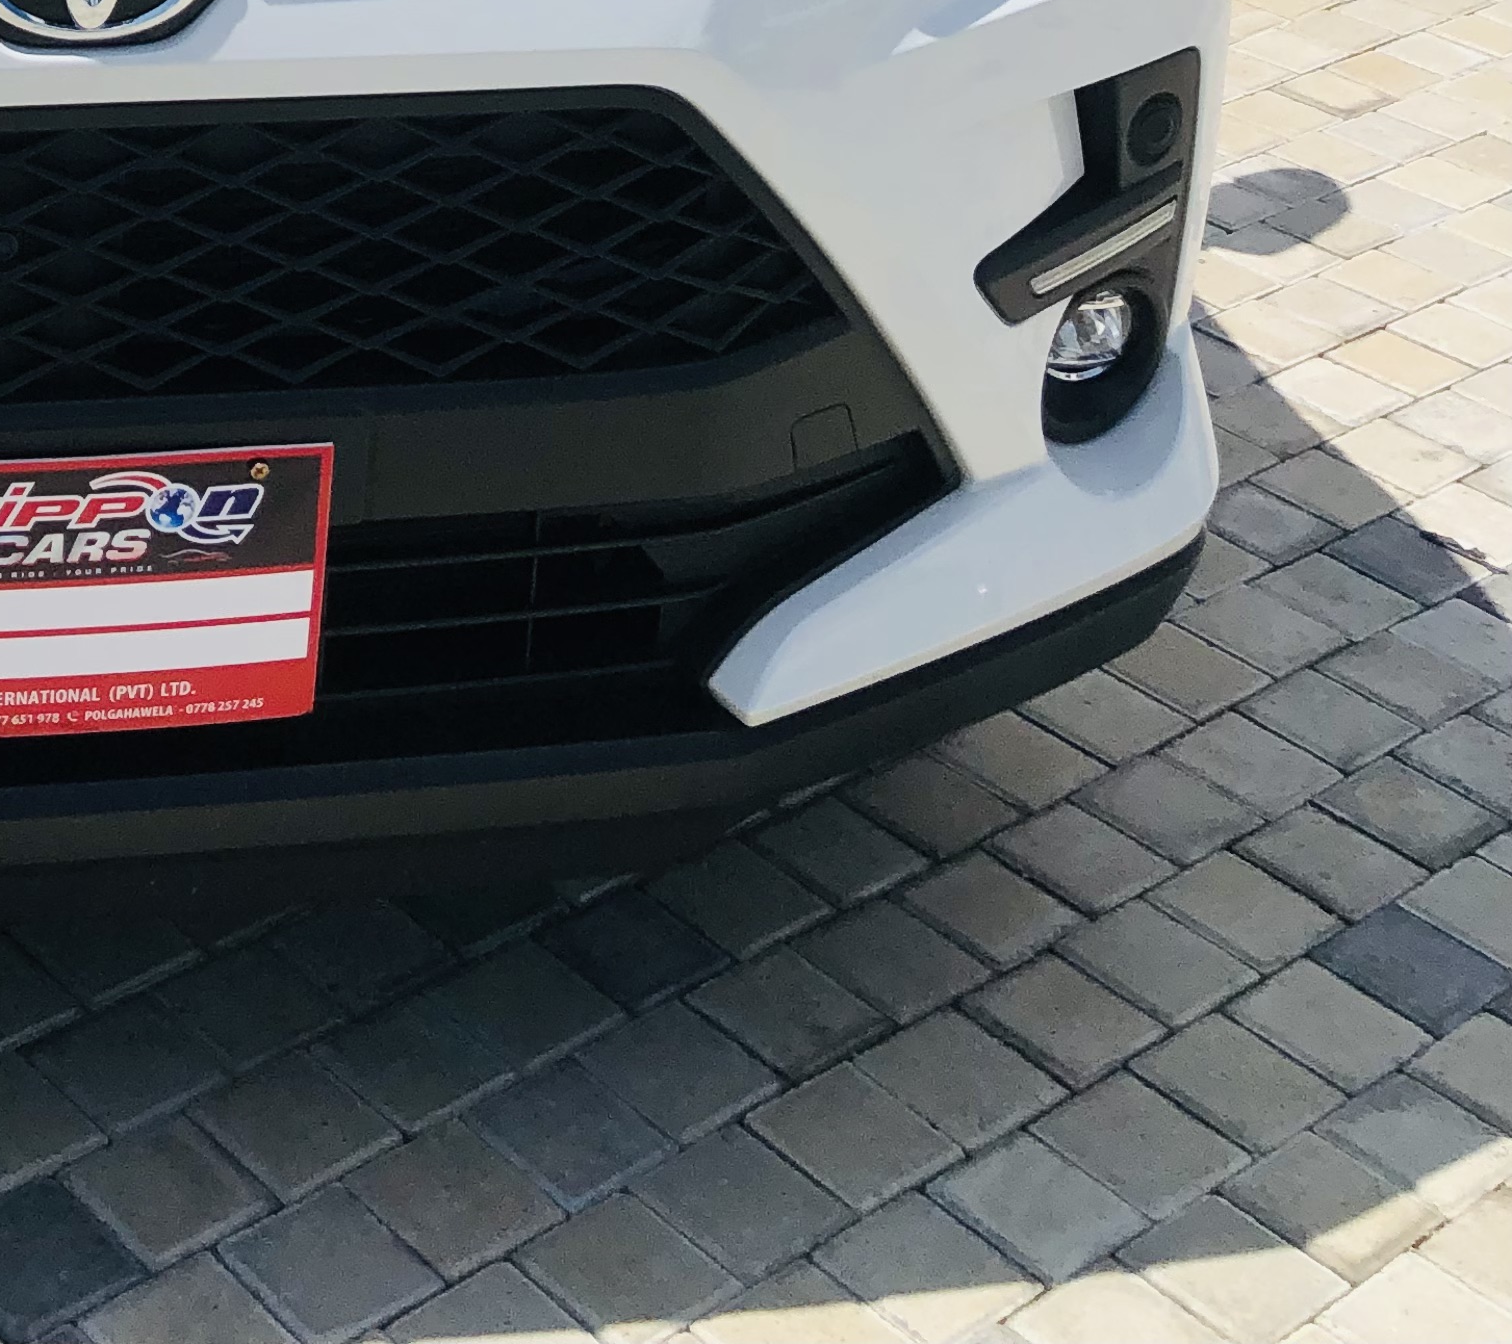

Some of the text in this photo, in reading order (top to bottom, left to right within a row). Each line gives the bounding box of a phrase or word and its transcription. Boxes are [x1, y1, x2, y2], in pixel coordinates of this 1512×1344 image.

[66, 567, 101, 575] YOUR
[110, 565, 153, 574] PRIDE
[109, 683, 154, 703] (PVT)
[160, 680, 196, 697] LTD.
[11, 714, 33, 726] 651
[36, 712, 60, 724] 978
[84, 705, 174, 722] POLGAHAWELA
[217, 699, 239, 712] 257
[241, 697, 264, 710] 245
